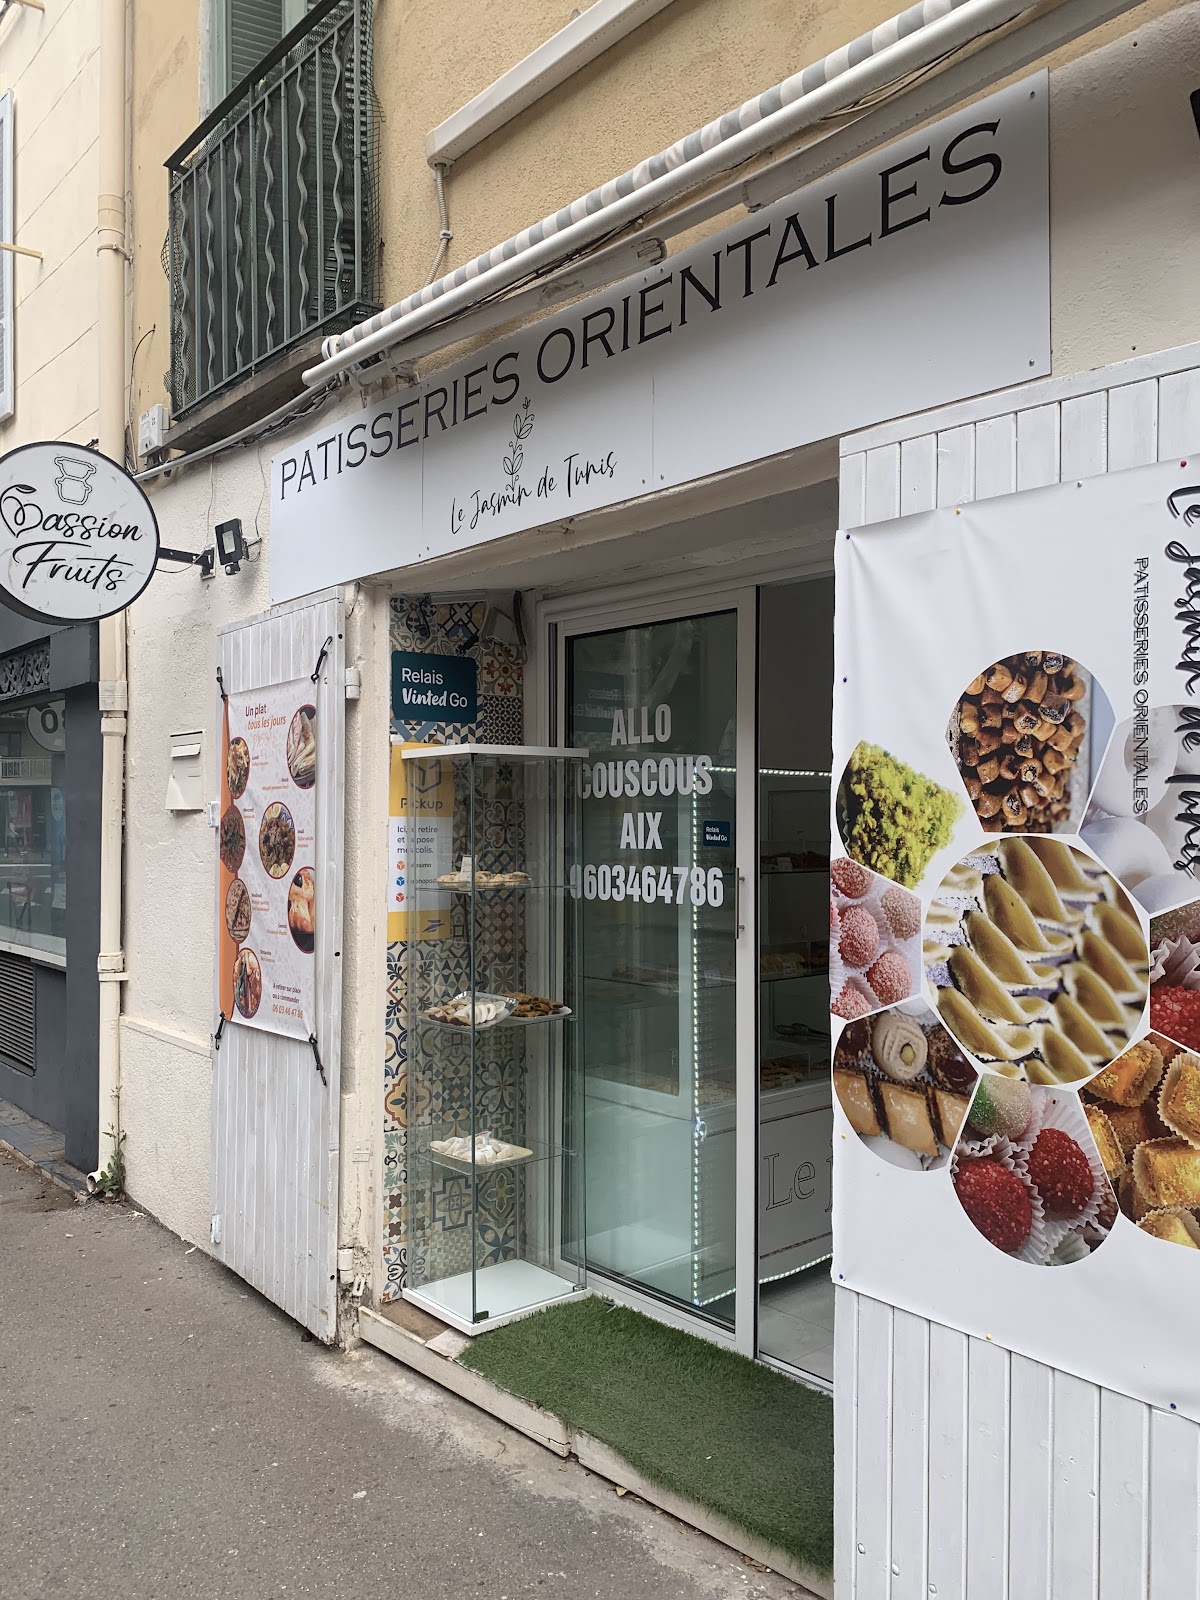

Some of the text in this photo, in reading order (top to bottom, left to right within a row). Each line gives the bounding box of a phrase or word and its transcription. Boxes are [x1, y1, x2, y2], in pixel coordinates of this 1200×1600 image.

[281, 118, 1002, 501] PATISSERIES ORIENTALES
[451, 451, 618, 535] Le Jasmin de Tunis
[12, 541, 135, 591] Fruits
[401, 667, 444, 686] Relais
[402, 687, 468, 708] Vinted Go
[1133, 556, 1149, 815] PATISSERIES ORIENTALES
[245, 703, 267, 718] Un plat
[247, 715, 287, 730] tous les jours
[610, 703, 672, 746] ALLO
[577, 754, 713, 800] COUSCOUS
[400, 797, 444, 812] Pckup
[418, 825, 439, 833] retire
[619, 811, 663, 850] AIX
[569, 863, 724, 908] 0603464786
[763, 1152, 816, 1211] Le
